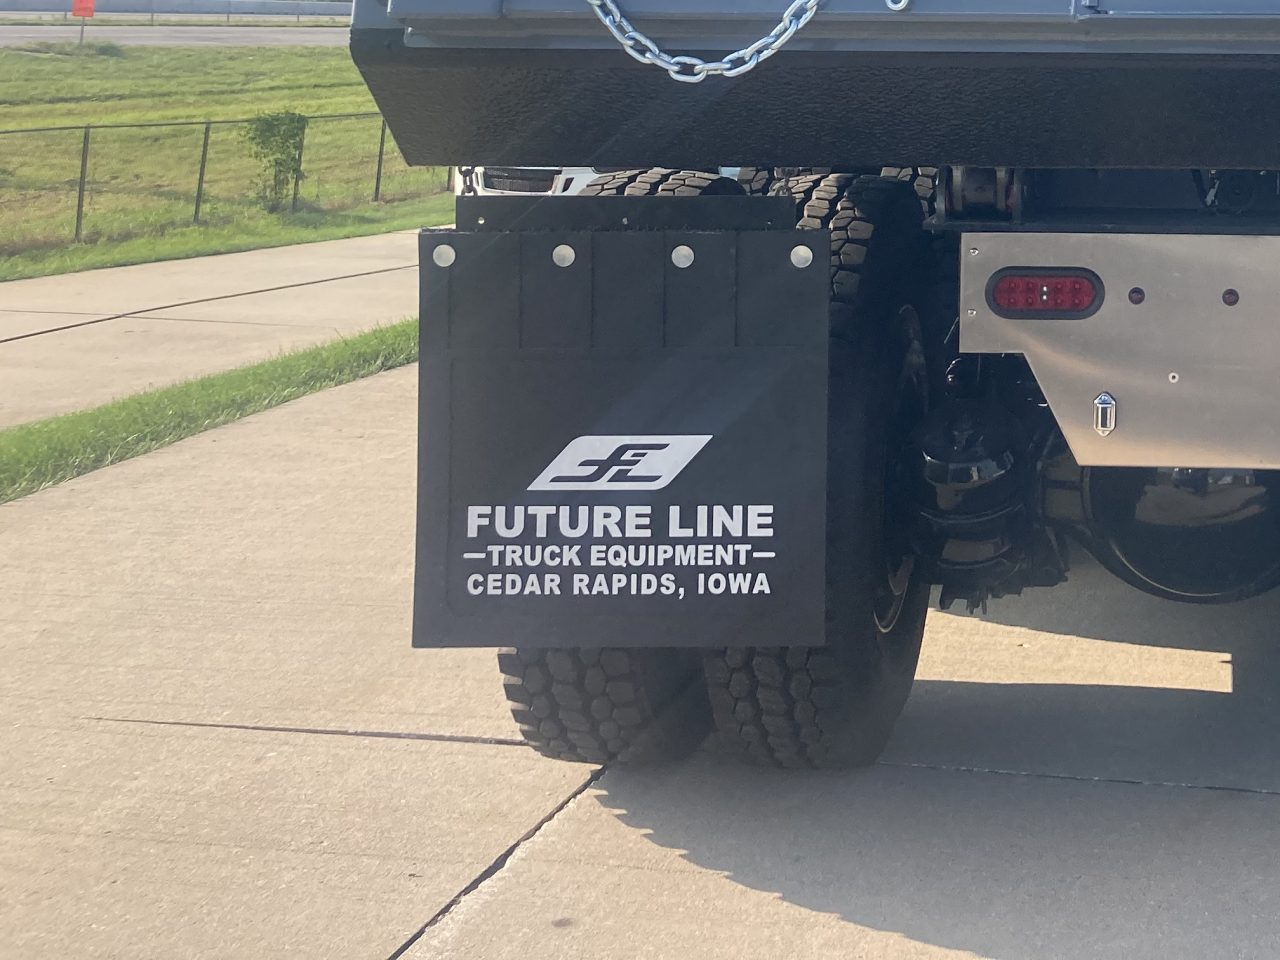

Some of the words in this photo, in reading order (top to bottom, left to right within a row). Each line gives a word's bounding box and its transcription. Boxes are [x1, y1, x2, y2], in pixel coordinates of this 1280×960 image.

[466, 505, 652, 538] FUTURE
[668, 505, 774, 538] LINE
[486, 544, 582, 567] TRUCK
[467, 573, 561, 596] CEDAR
[573, 573, 686, 600] RAPIDS,
[698, 572, 771, 595] IOWA
